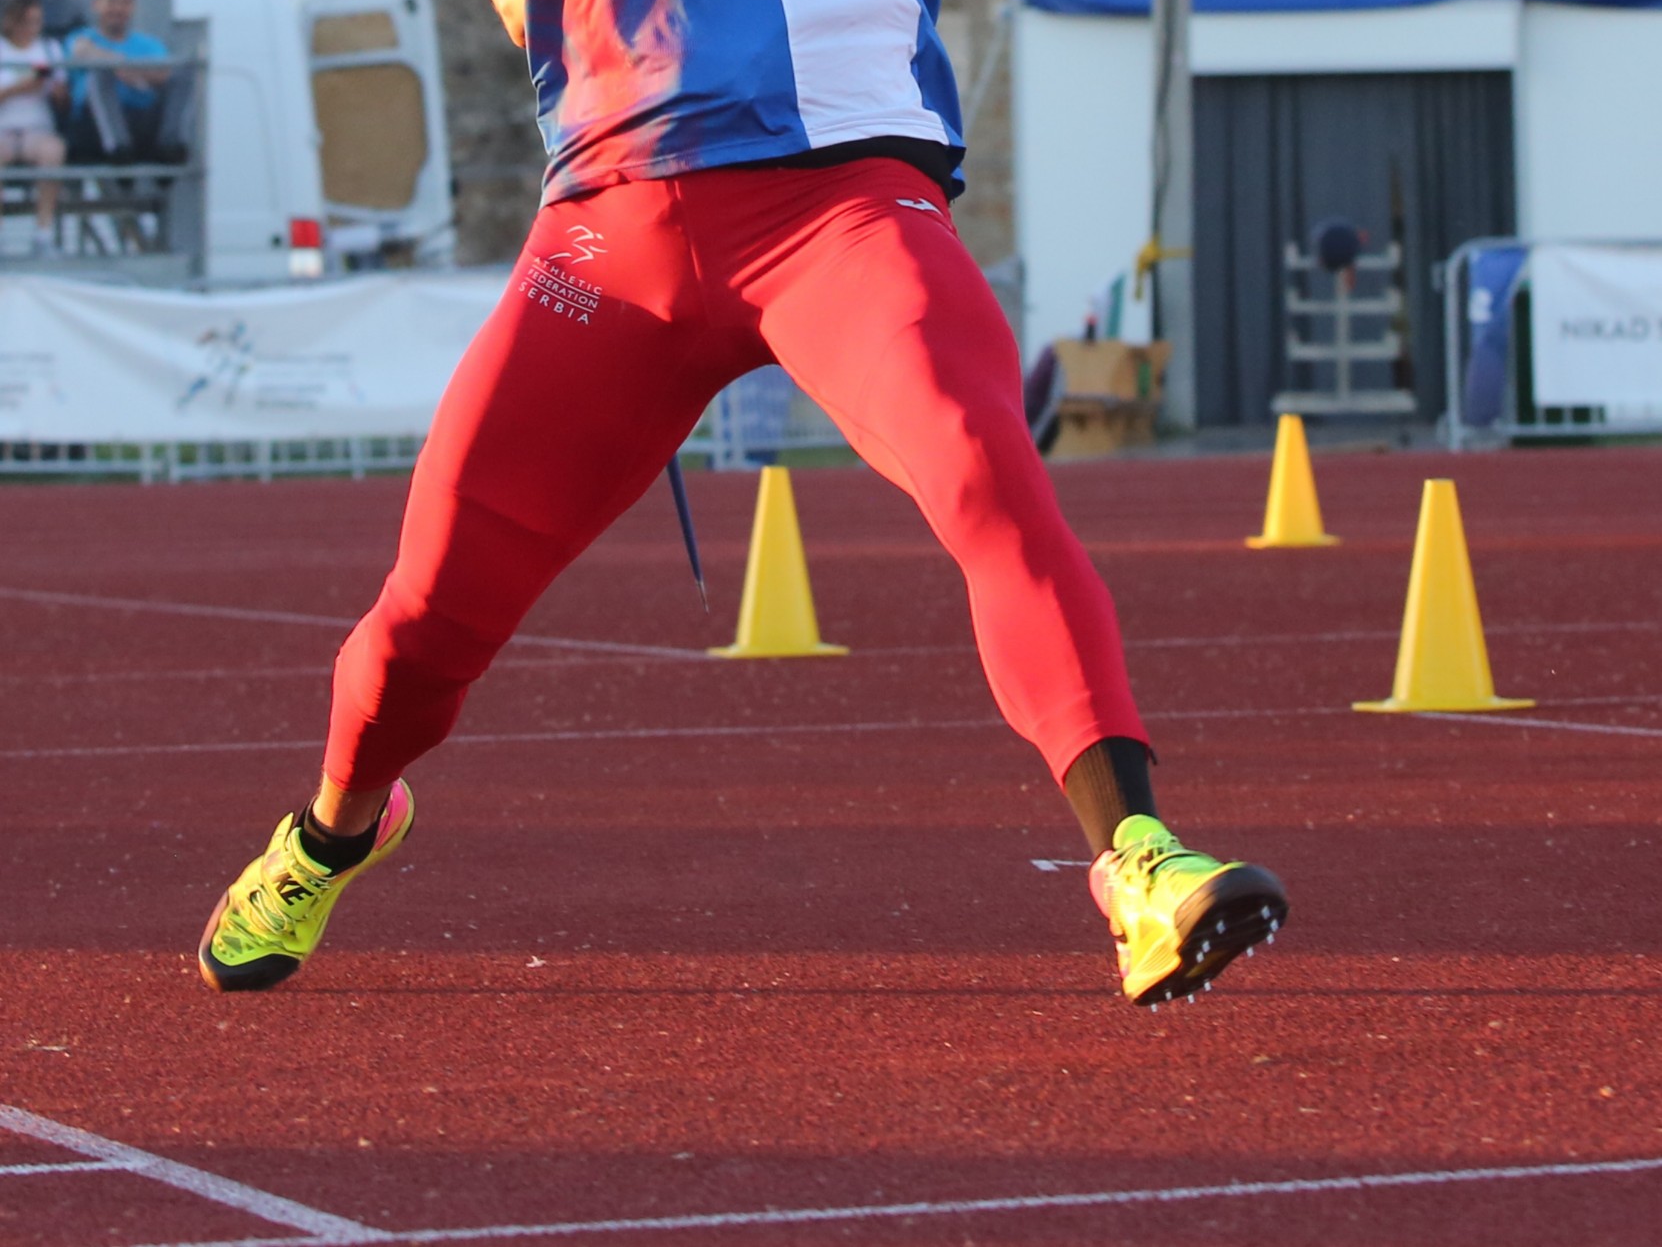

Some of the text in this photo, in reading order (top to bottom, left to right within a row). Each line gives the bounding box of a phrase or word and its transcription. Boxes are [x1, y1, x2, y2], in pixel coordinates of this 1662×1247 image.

[527, 268, 598, 309] FEDERATION
[533, 256, 602, 295] ATHLETIC
[519, 282, 590, 325] SERBIA
